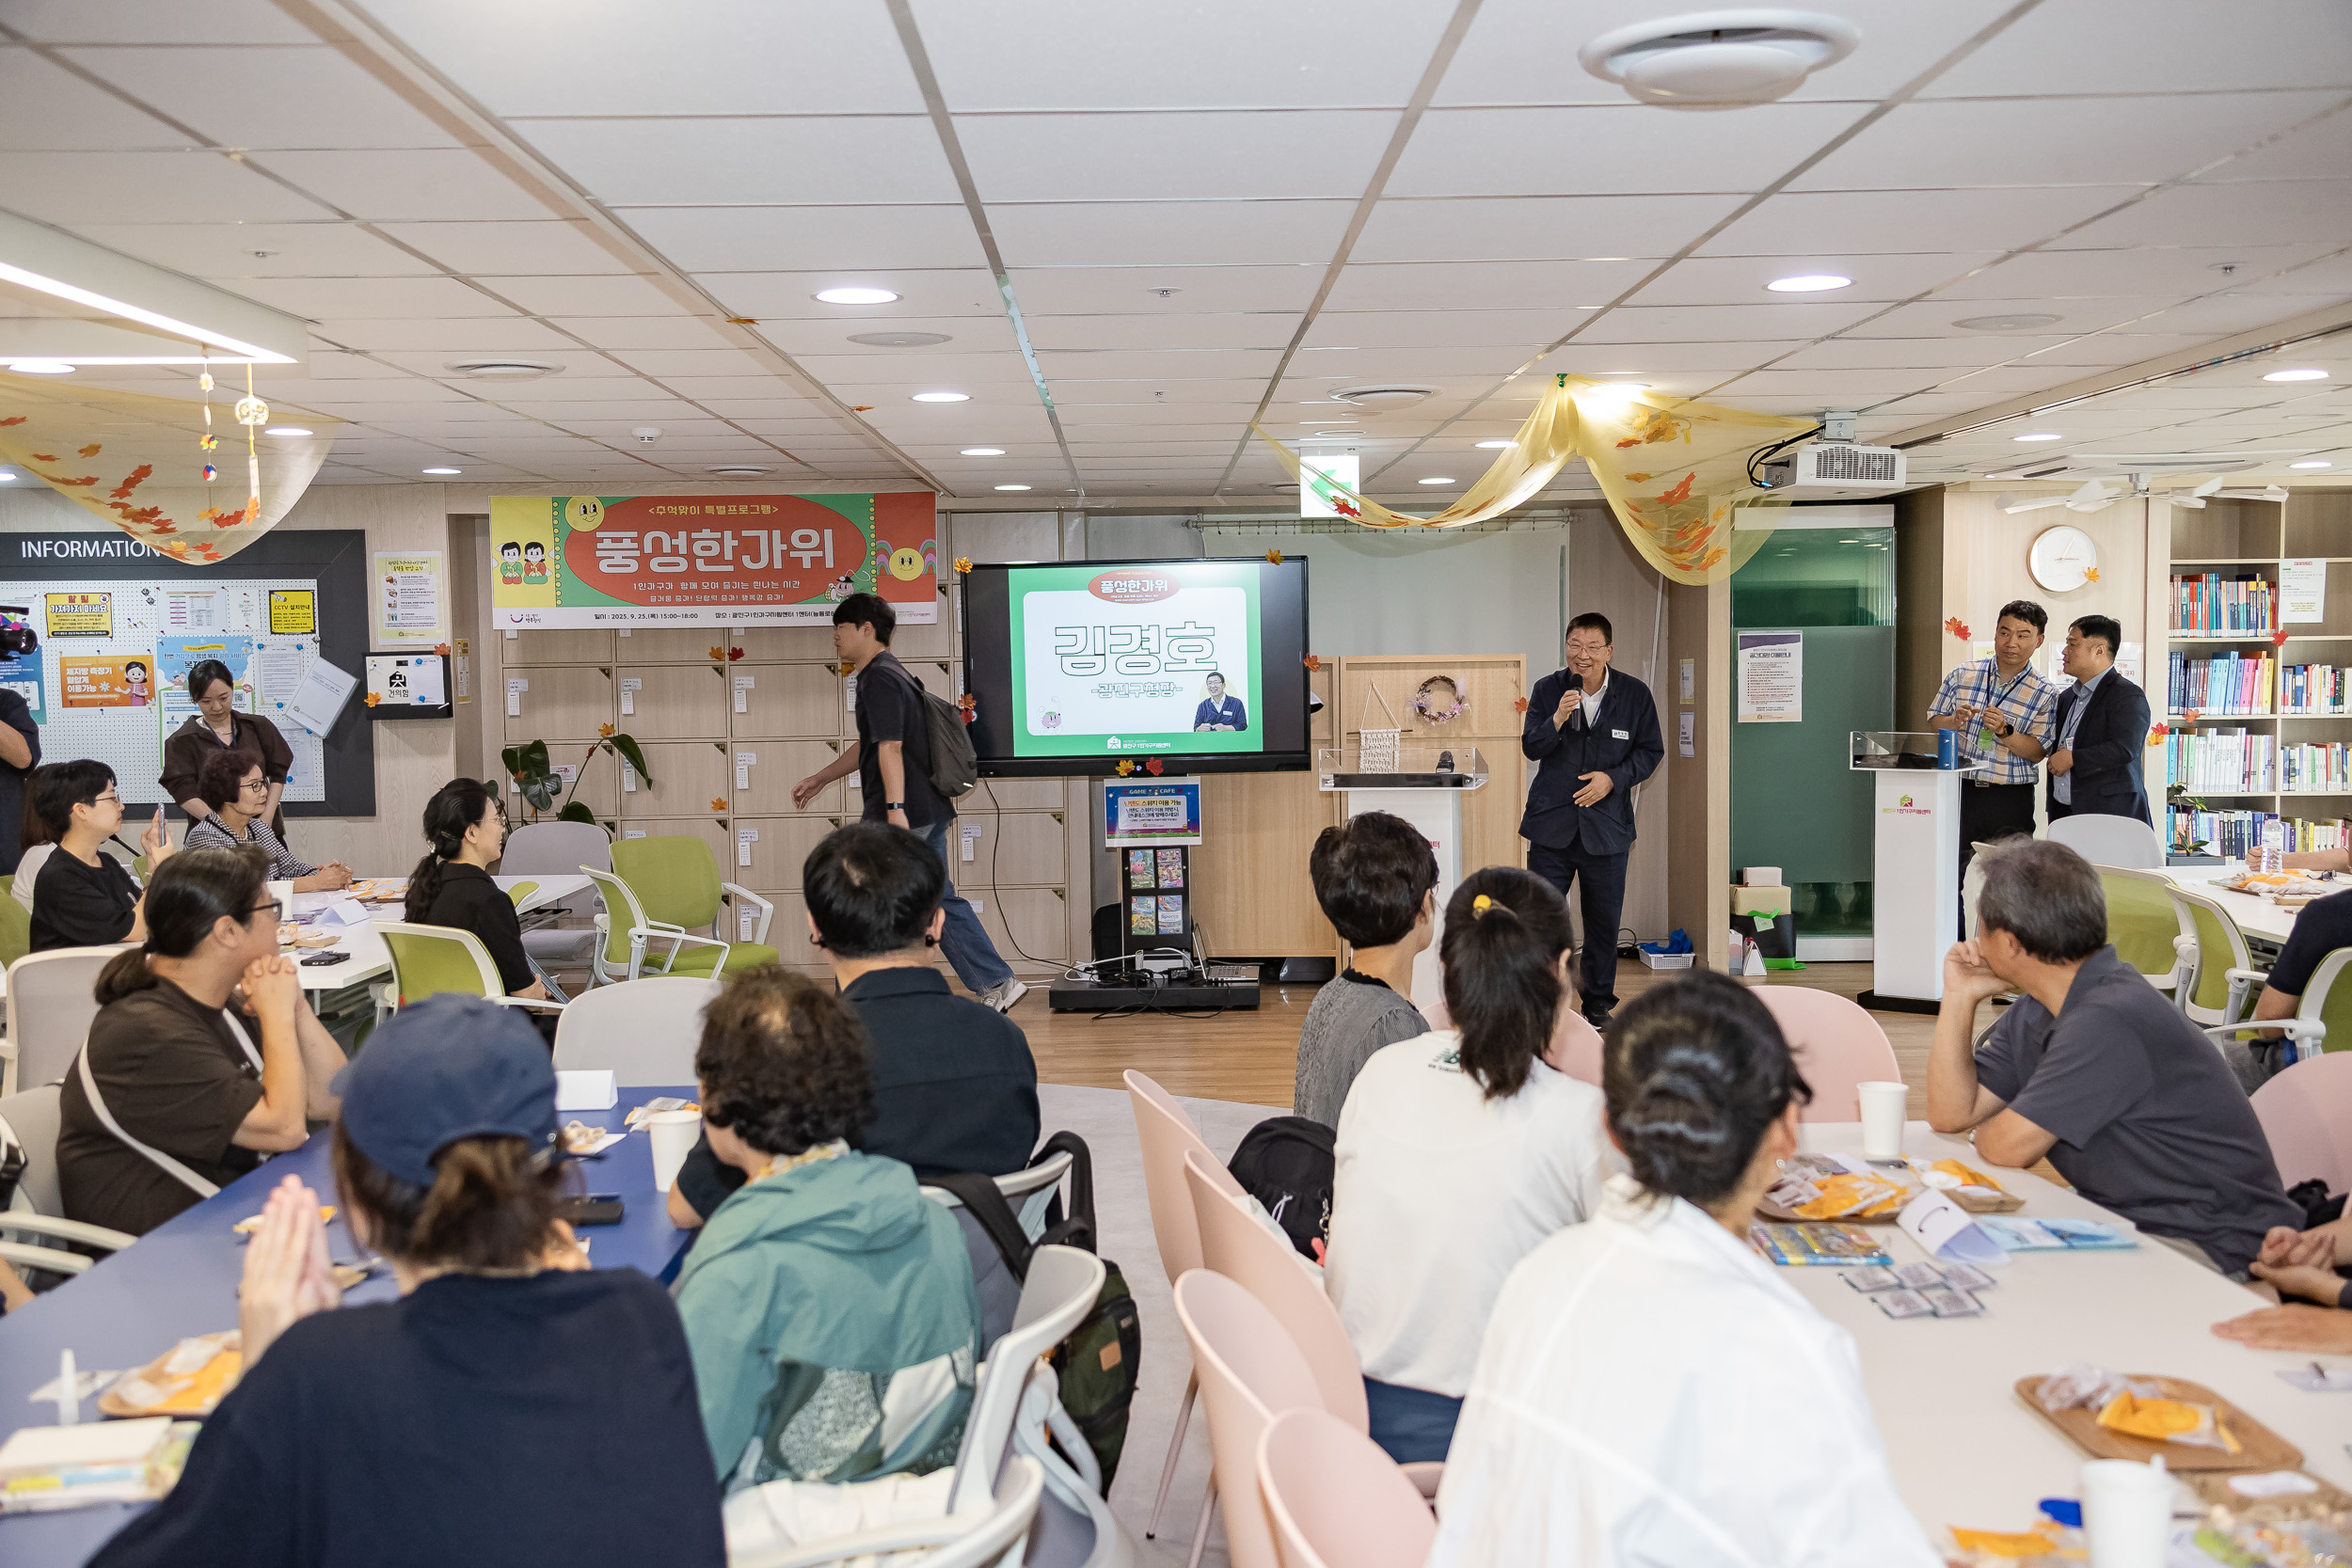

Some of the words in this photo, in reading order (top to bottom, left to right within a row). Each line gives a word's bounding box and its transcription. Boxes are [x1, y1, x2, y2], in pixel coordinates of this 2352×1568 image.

[648, 505, 700, 515] <추석맞이
[705, 504, 779, 515] 특별프로그램>
[21, 540, 161, 558] INFORMATION
[595, 528, 834, 574] 풍성한가위
[633, 582, 674, 591] 1인가구가
[680, 581, 698, 591] 함께
[701, 581, 719, 590] 모여
[723, 581, 749, 590] 즐기는
[783, 580, 801, 589] 시간
[1100, 578, 1168, 594] 풍성한가위
[50, 605, 82, 613] 가져가지
[84, 604, 109, 613] 마세요
[1055, 621, 1218, 676] 김경호
[67, 684, 97, 693] 이용가능
[389, 689, 409, 698] 건의함
